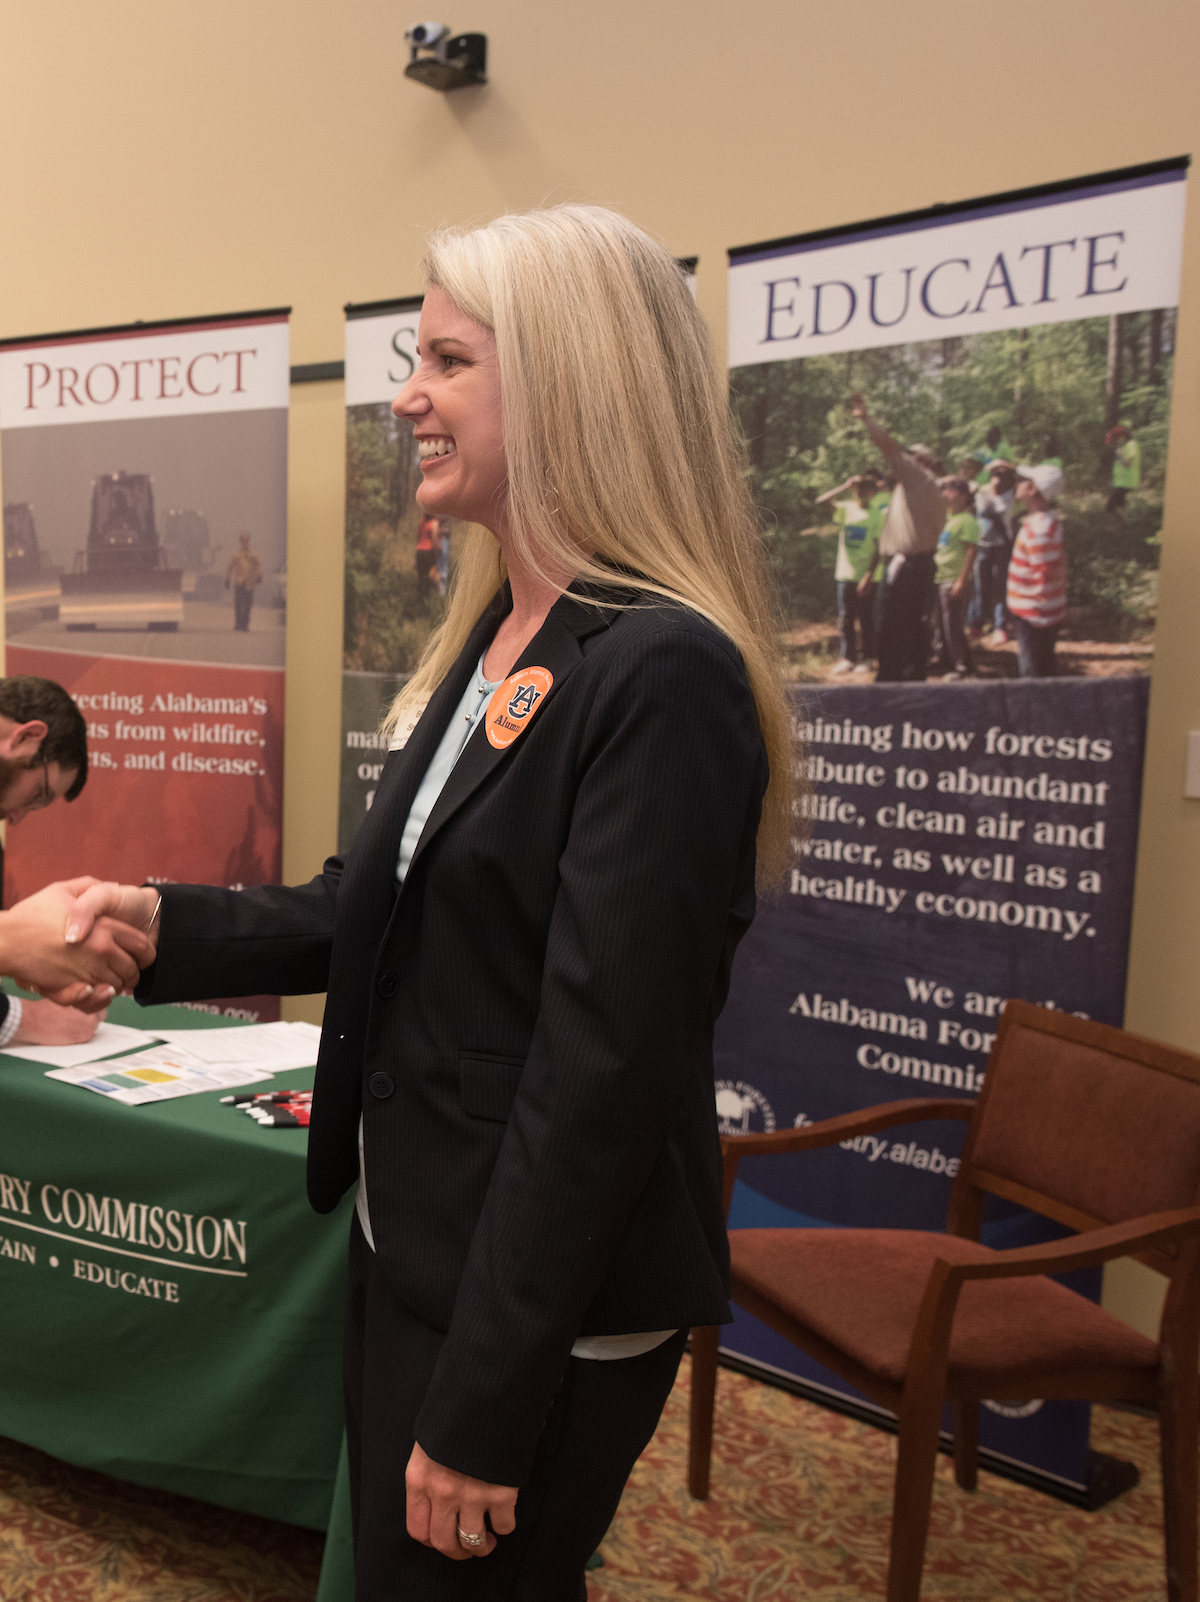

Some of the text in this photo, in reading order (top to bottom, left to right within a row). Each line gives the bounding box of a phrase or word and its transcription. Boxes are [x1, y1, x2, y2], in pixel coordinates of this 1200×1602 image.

[759, 231, 1129, 345] EDUCATE
[22, 348, 257, 410] PROTECT
[150, 692, 268, 716] Alabama's
[114, 720, 166, 742] from
[173, 723, 267, 748] wildfire,
[901, 721, 976, 752] how
[984, 726, 1113, 763] forests
[124, 751, 166, 771] and
[171, 752, 267, 777] disease.
[895, 764, 930, 791] to
[936, 766, 1110, 807] abundant
[875, 802, 967, 836] clean
[976, 811, 1026, 842] air
[1033, 821, 1106, 850] and
[790, 837, 1102, 894] water, as well as a
[789, 868, 1098, 942] healthy economy.
[905, 976, 955, 1009] We
[788, 992, 998, 1055] Alabama For
[40, 1184, 248, 1265] COMMISSION
[72, 1258, 180, 1304] EDUCATE
